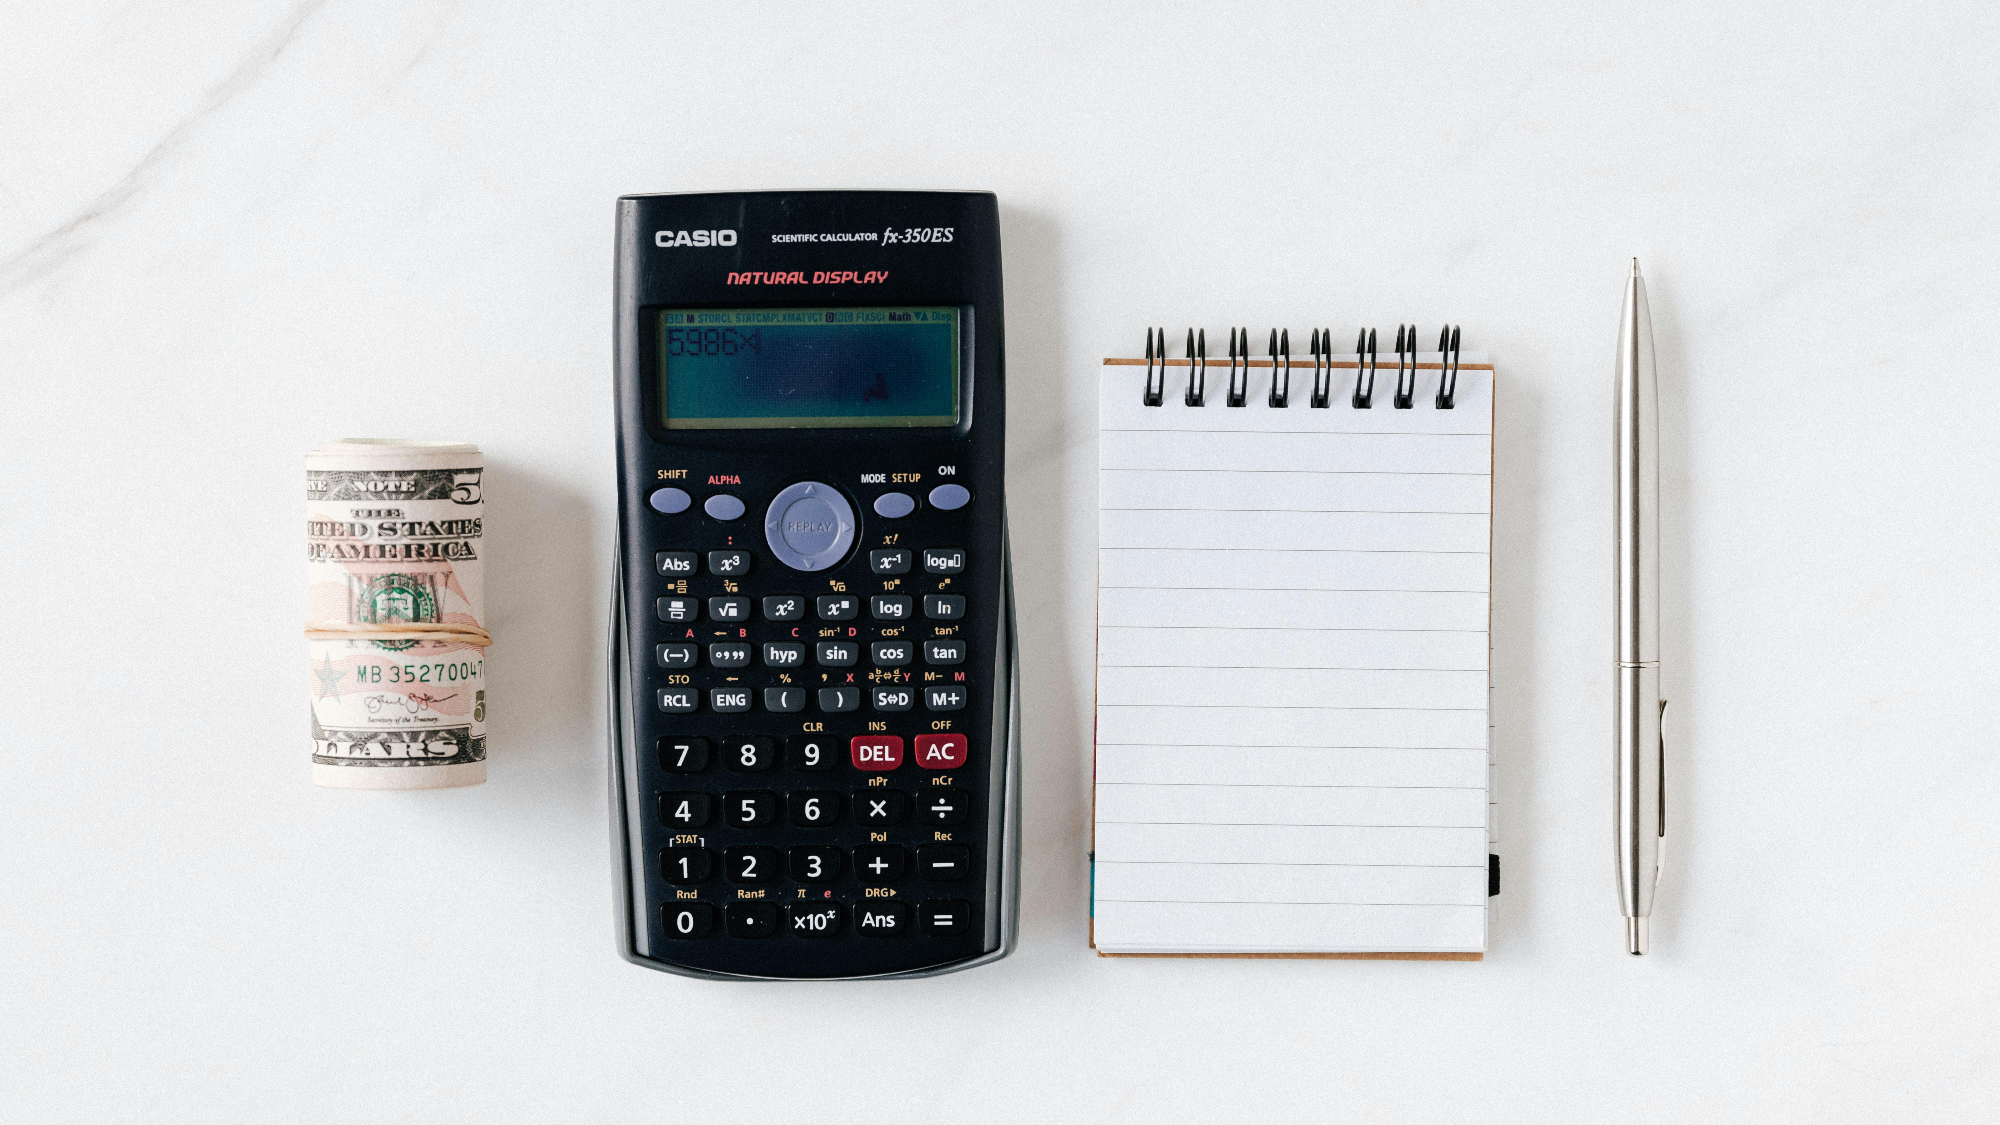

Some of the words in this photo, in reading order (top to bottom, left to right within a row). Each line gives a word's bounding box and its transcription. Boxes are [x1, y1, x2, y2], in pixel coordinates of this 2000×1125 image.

[655, 229, 738, 248] CASIO
[771, 233, 819, 243] SCIENTIFIC
[820, 232, 878, 242] CALCULATOR
[881, 227, 955, 247] fx-350ES
[727, 271, 809, 285] NATURAL
[812, 271, 889, 285] DISPLAY
[888, 311, 912, 322] Math
[931, 311, 952, 324] Disp
[657, 469, 688, 479] SHIFT
[938, 465, 956, 476] ON
[708, 475, 741, 485] ALPHA
[861, 474, 886, 484] MODE
[892, 473, 921, 483] SETUP
[354, 480, 416, 492] NOTE
[351, 508, 404, 519] THE
[378, 517, 483, 541] STATES
[788, 521, 832, 533] REPLAY
[331, 541, 478, 563] AMERICA
[662, 558, 691, 571] Abs
[879, 600, 903, 616] log
[685, 629, 695, 638] A
[739, 628, 747, 637] B
[791, 627, 799, 637] C
[848, 627, 857, 637] D
[770, 647, 798, 663] hyp
[826, 646, 848, 660] sin
[879, 647, 904, 659] cos
[932, 646, 957, 659] tan
[668, 675, 690, 684] STO
[779, 673, 792, 684] %
[846, 673, 854, 683] X
[903, 672, 911, 682] Y
[954, 672, 965, 681] M
[663, 694, 691, 707] RCL
[716, 694, 746, 707] ENG
[780, 691, 787, 708] (
[836, 691, 843, 708] )
[932, 692, 960, 706] M+
[802, 722, 824, 732] CLR
[868, 721, 887, 731] INS
[931, 720, 952, 730] OFF
[674, 745, 690, 767] 7
[740, 744, 757, 767] 8
[804, 743, 820, 766] 9
[859, 745, 896, 762] DEL
[926, 743, 955, 760] AC
[868, 776, 888, 787] nPr
[932, 775, 953, 785] nCr
[674, 800, 692, 822] 4
[741, 799, 756, 822] 5
[804, 798, 821, 821] 6
[675, 834, 698, 844] STAT
[870, 831, 887, 842] Pol
[934, 831, 952, 841] Rec
[678, 857, 689, 879] 1
[741, 855, 757, 878] 2
[806, 855, 822, 878] 3
[676, 889, 698, 899] Rnd
[737, 889, 766, 899] Ran#
[865, 888, 889, 898] DRG
[676, 911, 694, 934] 0
[861, 911, 896, 928] Ans
[933, 914, 953, 926] =
